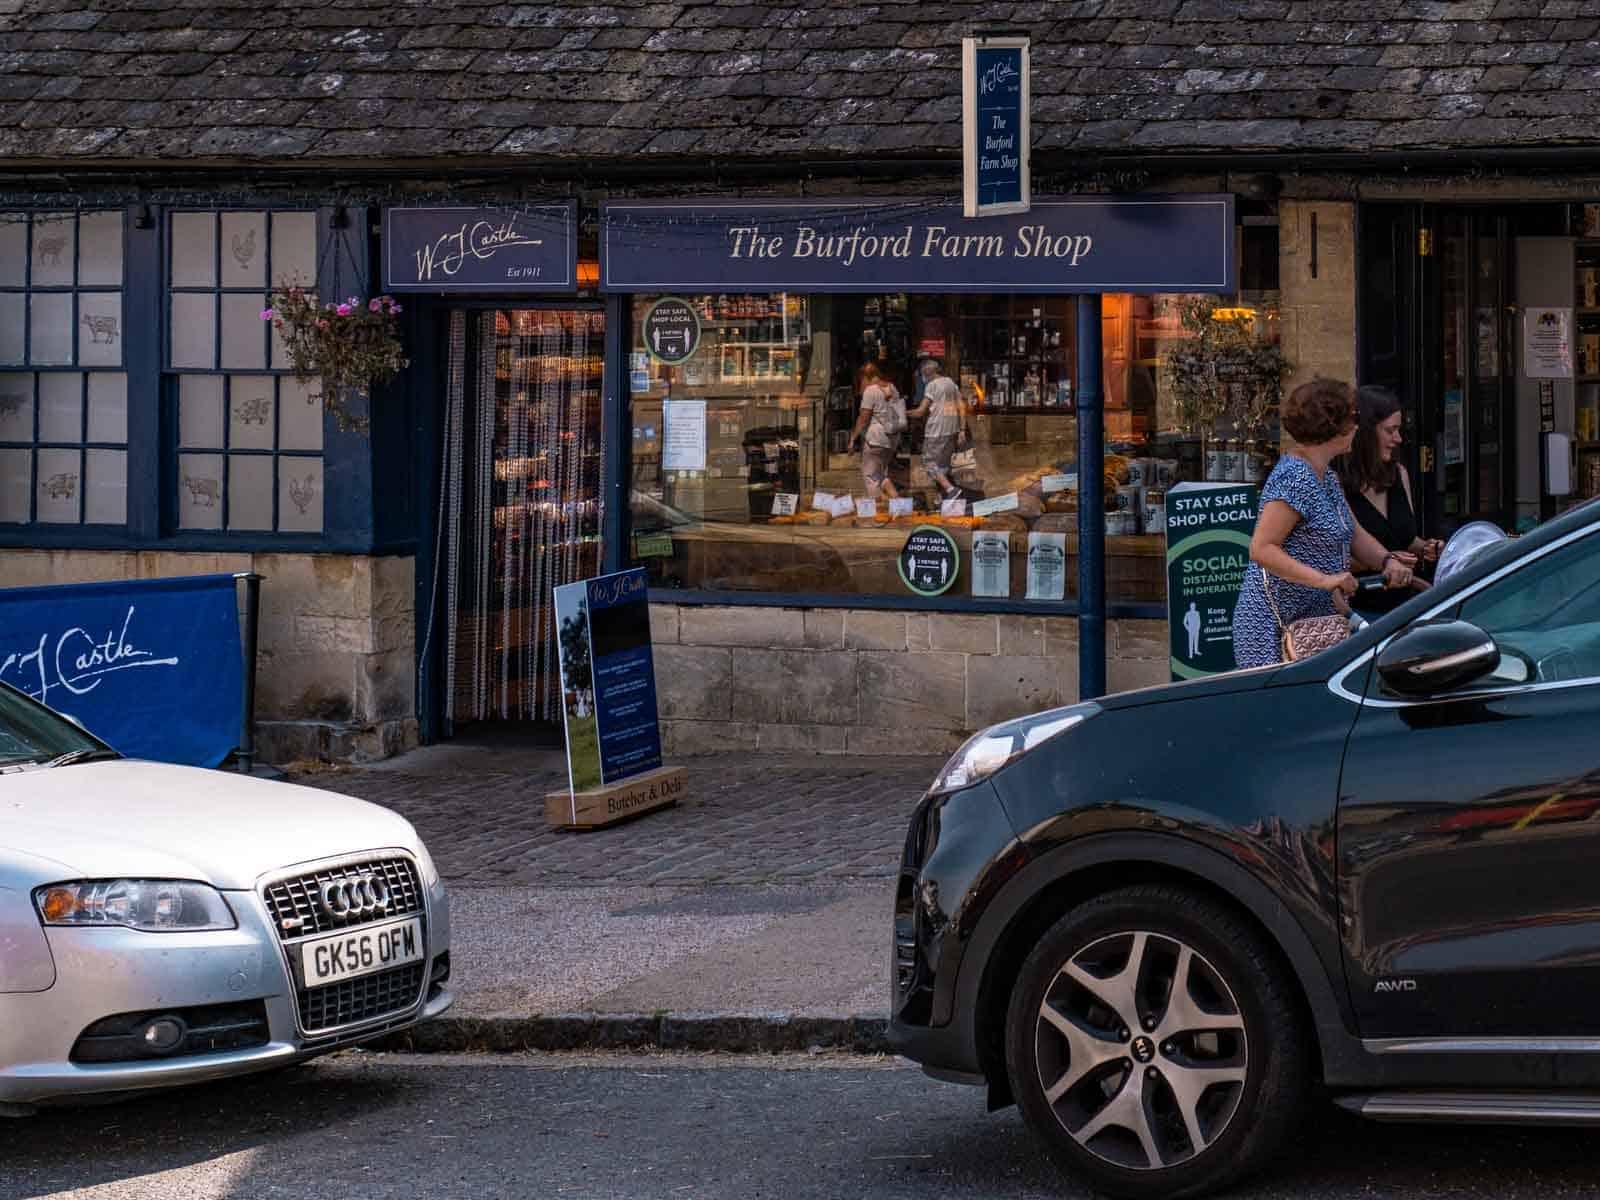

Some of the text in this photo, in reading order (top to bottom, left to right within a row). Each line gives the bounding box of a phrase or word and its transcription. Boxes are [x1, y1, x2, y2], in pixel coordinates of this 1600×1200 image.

[992, 115, 1007, 129] The
[985, 135, 1013, 153] Burford
[980, 154, 1018, 171] Farm Shop
[470, 210, 541, 259] Castle
[729, 225, 1092, 266] The Burford Farm Shop
[522, 266, 541, 277] 1911
[1175, 493, 1248, 511] STAY SAFE
[1168, 509, 1256, 527] SHOP LOCAL
[927, 545, 949, 553] LOCAL
[1183, 554, 1249, 573] SOCIAL
[1183, 586, 1193, 596] IN
[1207, 607, 1226, 616] Keep
[1214, 615, 1229, 624] safe
[56, 606, 178, 695] Castle
[607, 775, 681, 814] Butcher & Deli
[314, 924, 416, 978] GK56 OFM
[1373, 979, 1417, 993] AWD
